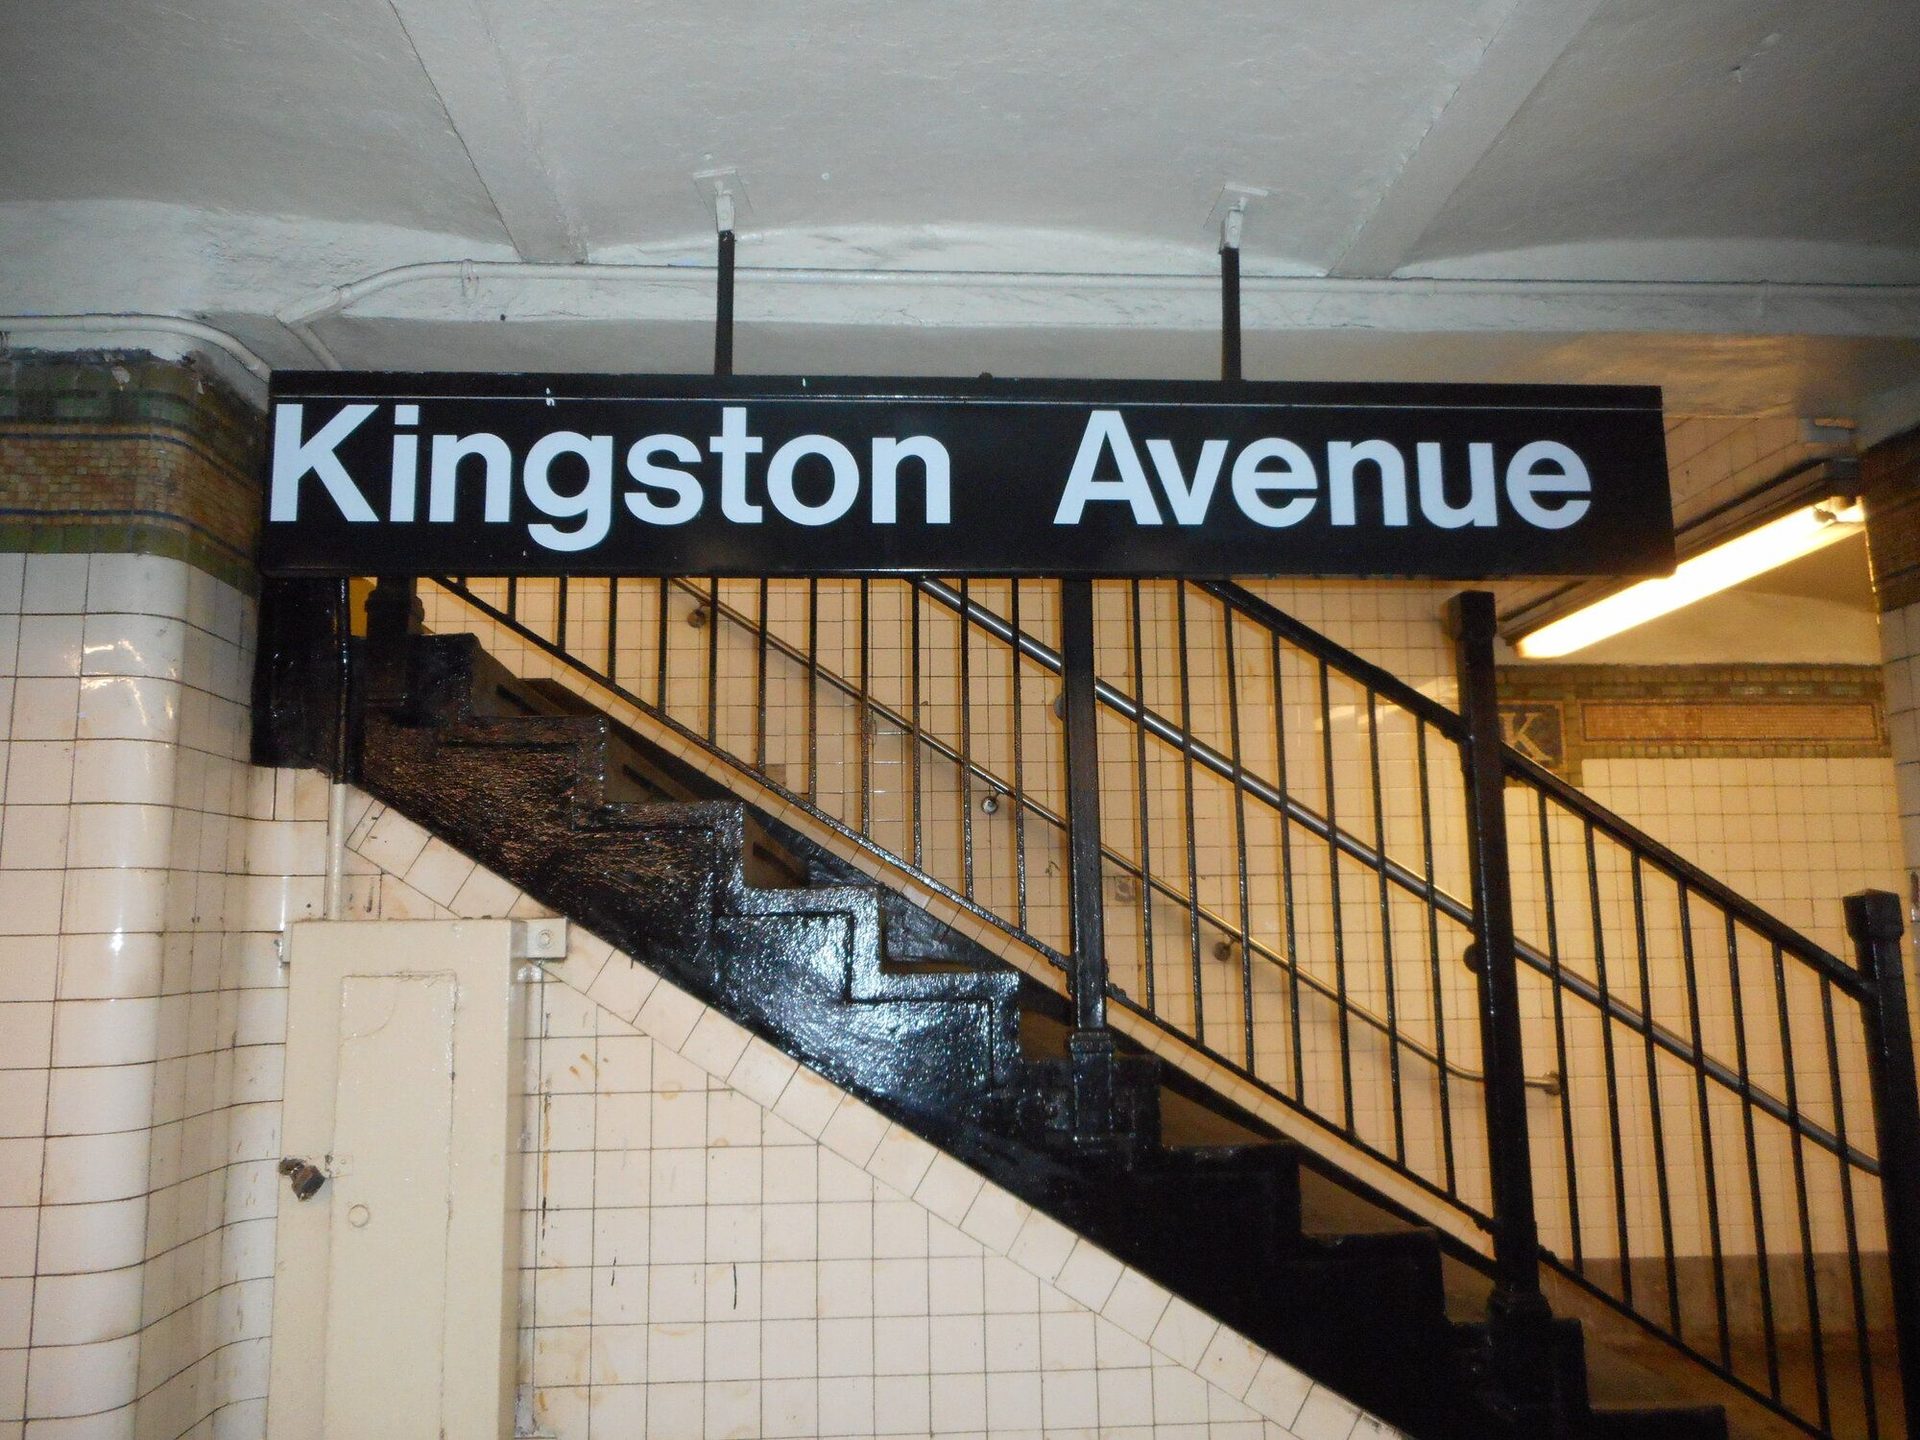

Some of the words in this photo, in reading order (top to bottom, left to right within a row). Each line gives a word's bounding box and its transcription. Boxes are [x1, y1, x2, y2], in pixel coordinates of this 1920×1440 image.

[270, 403, 951, 552] Kingston
[1054, 409, 1591, 529] Avenue
[1499, 712, 1553, 761] K
